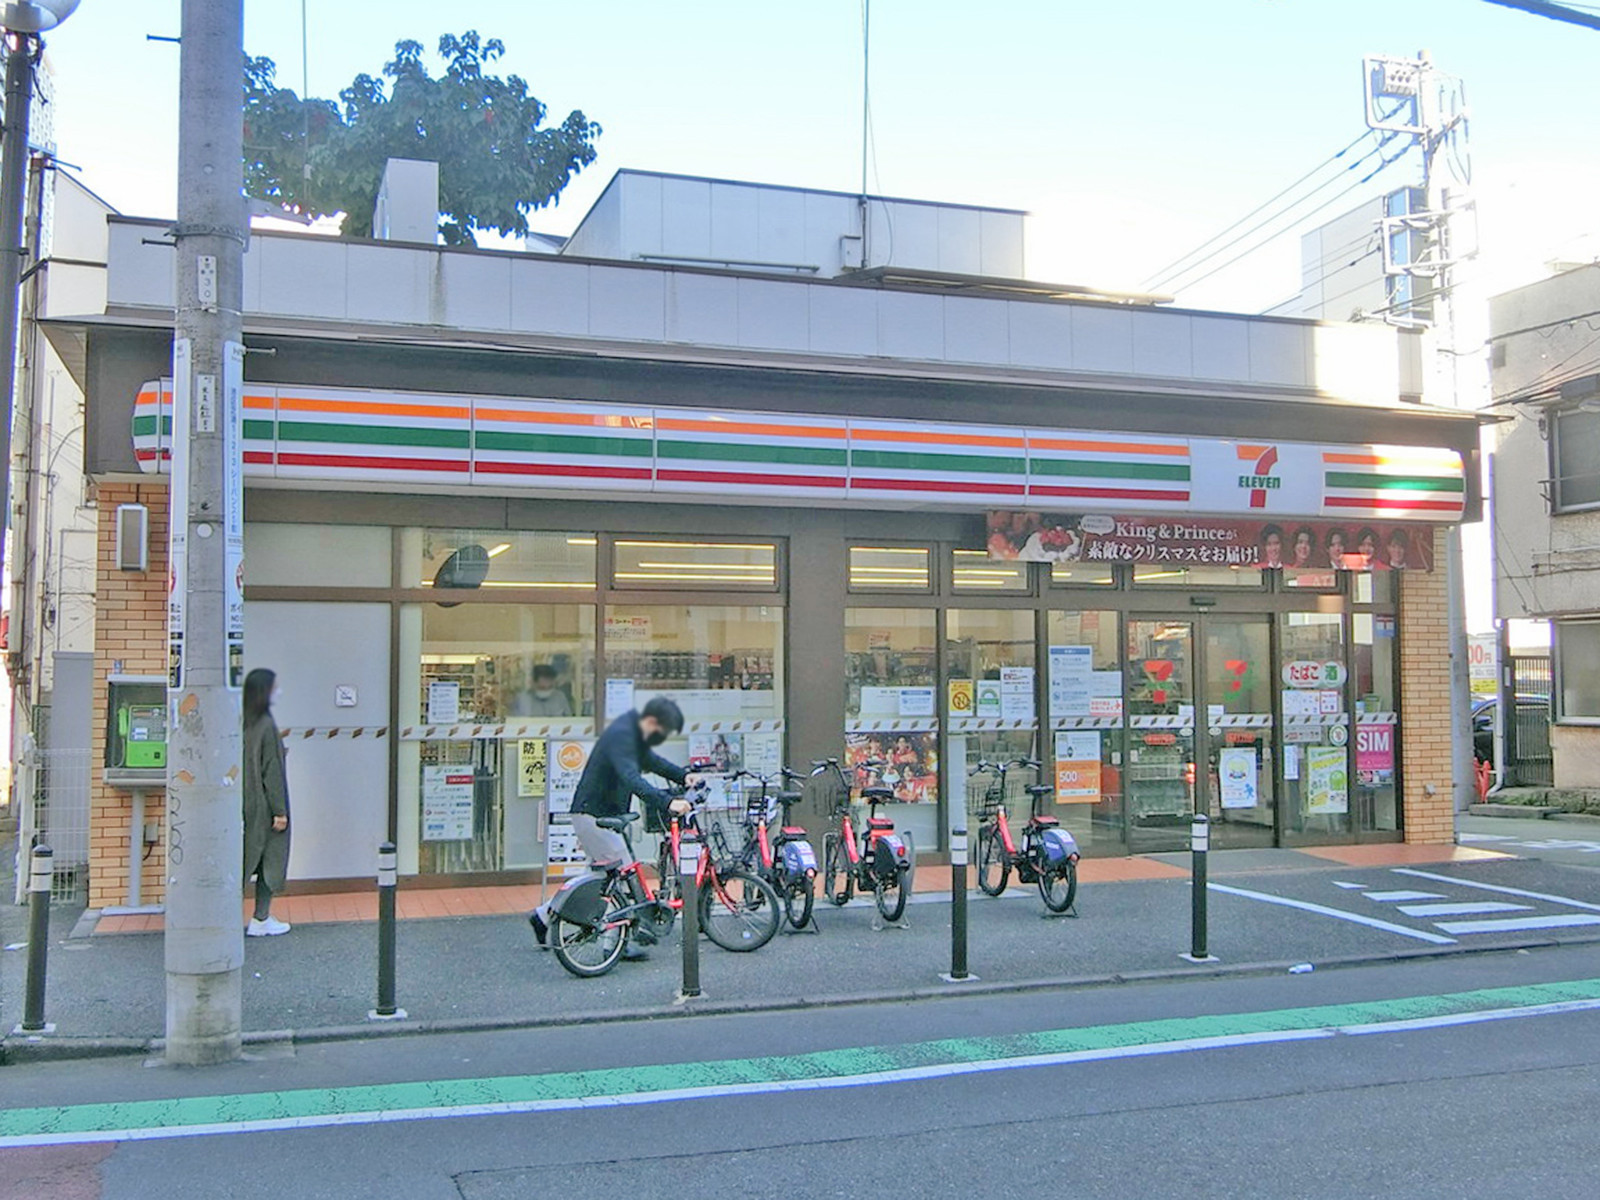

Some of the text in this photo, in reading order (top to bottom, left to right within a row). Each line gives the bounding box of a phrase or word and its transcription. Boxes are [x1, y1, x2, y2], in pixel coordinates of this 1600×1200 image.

[1236, 444, 1278, 508] 7
[1115, 521, 1158, 542] King
[1158, 523, 1172, 540] &
[1290, 665, 1320, 681] たばこ
[1325, 665, 1338, 681] 酒
[1357, 731, 1389, 752] SIM
[1060, 771, 1078, 782] 500
